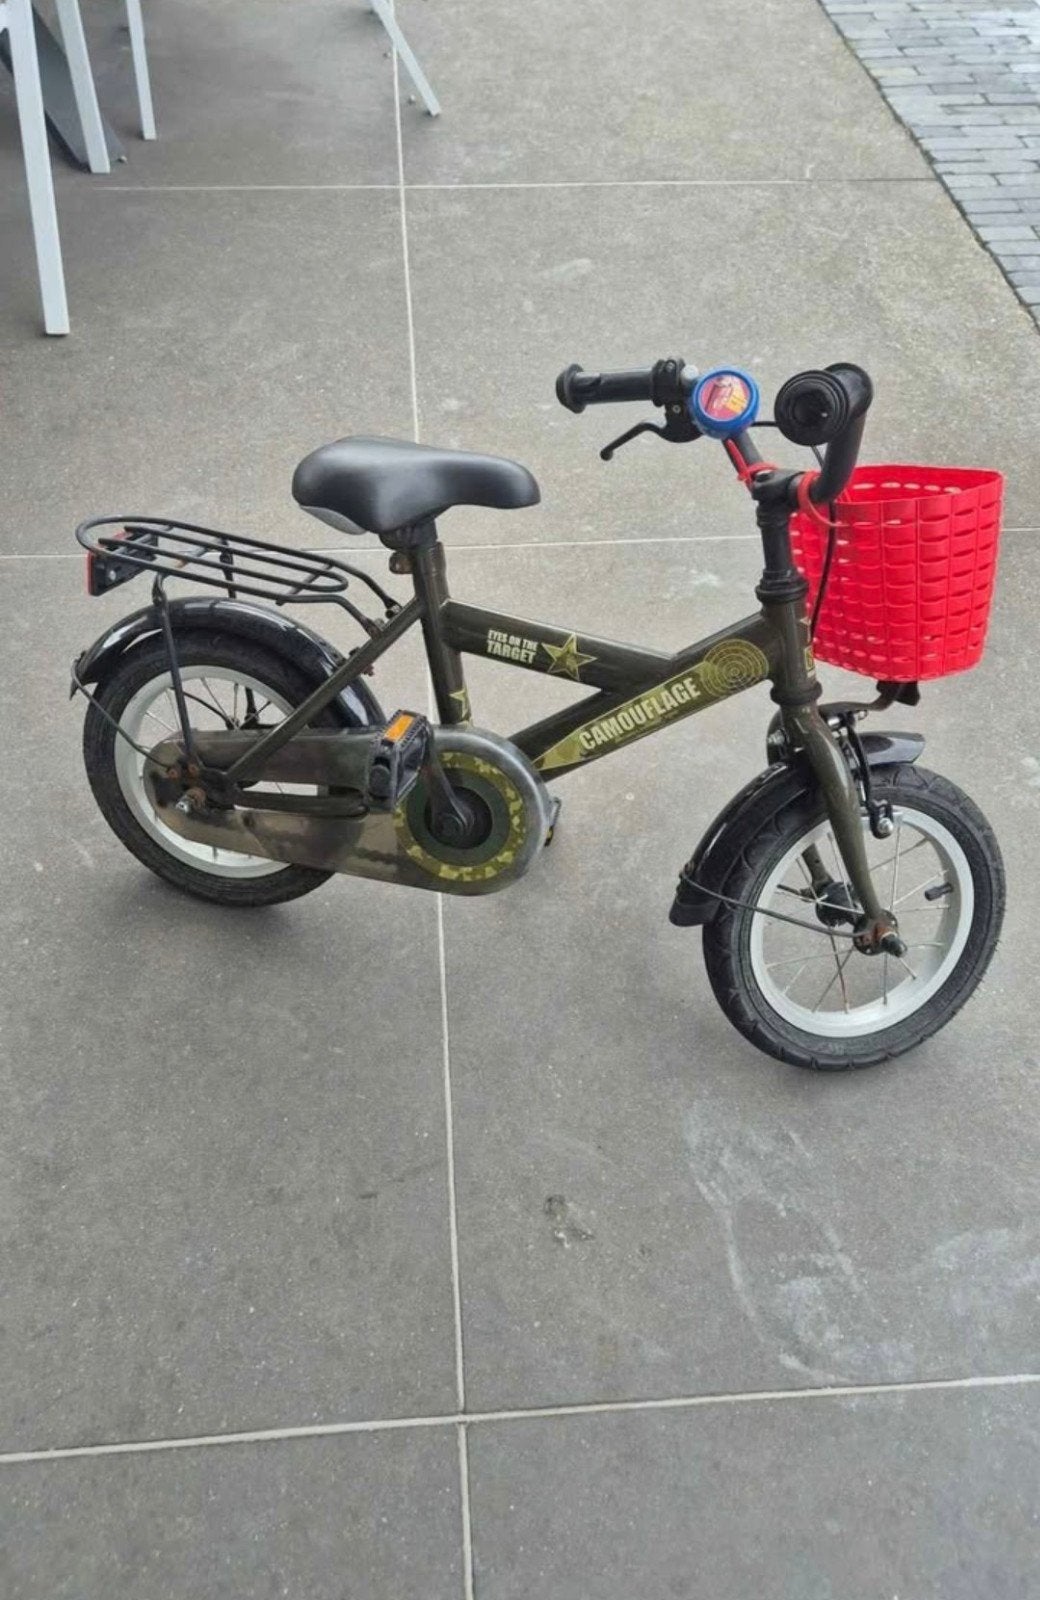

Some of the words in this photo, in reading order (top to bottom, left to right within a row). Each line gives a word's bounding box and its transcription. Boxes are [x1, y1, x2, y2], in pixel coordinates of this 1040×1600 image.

[487, 640, 536, 664] TARGET
[488, 629, 508, 643] EYES
[508, 635, 521, 647] ON
[522, 638, 538, 651] THE
[579, 677, 701, 750] CAMOUFLAGE
